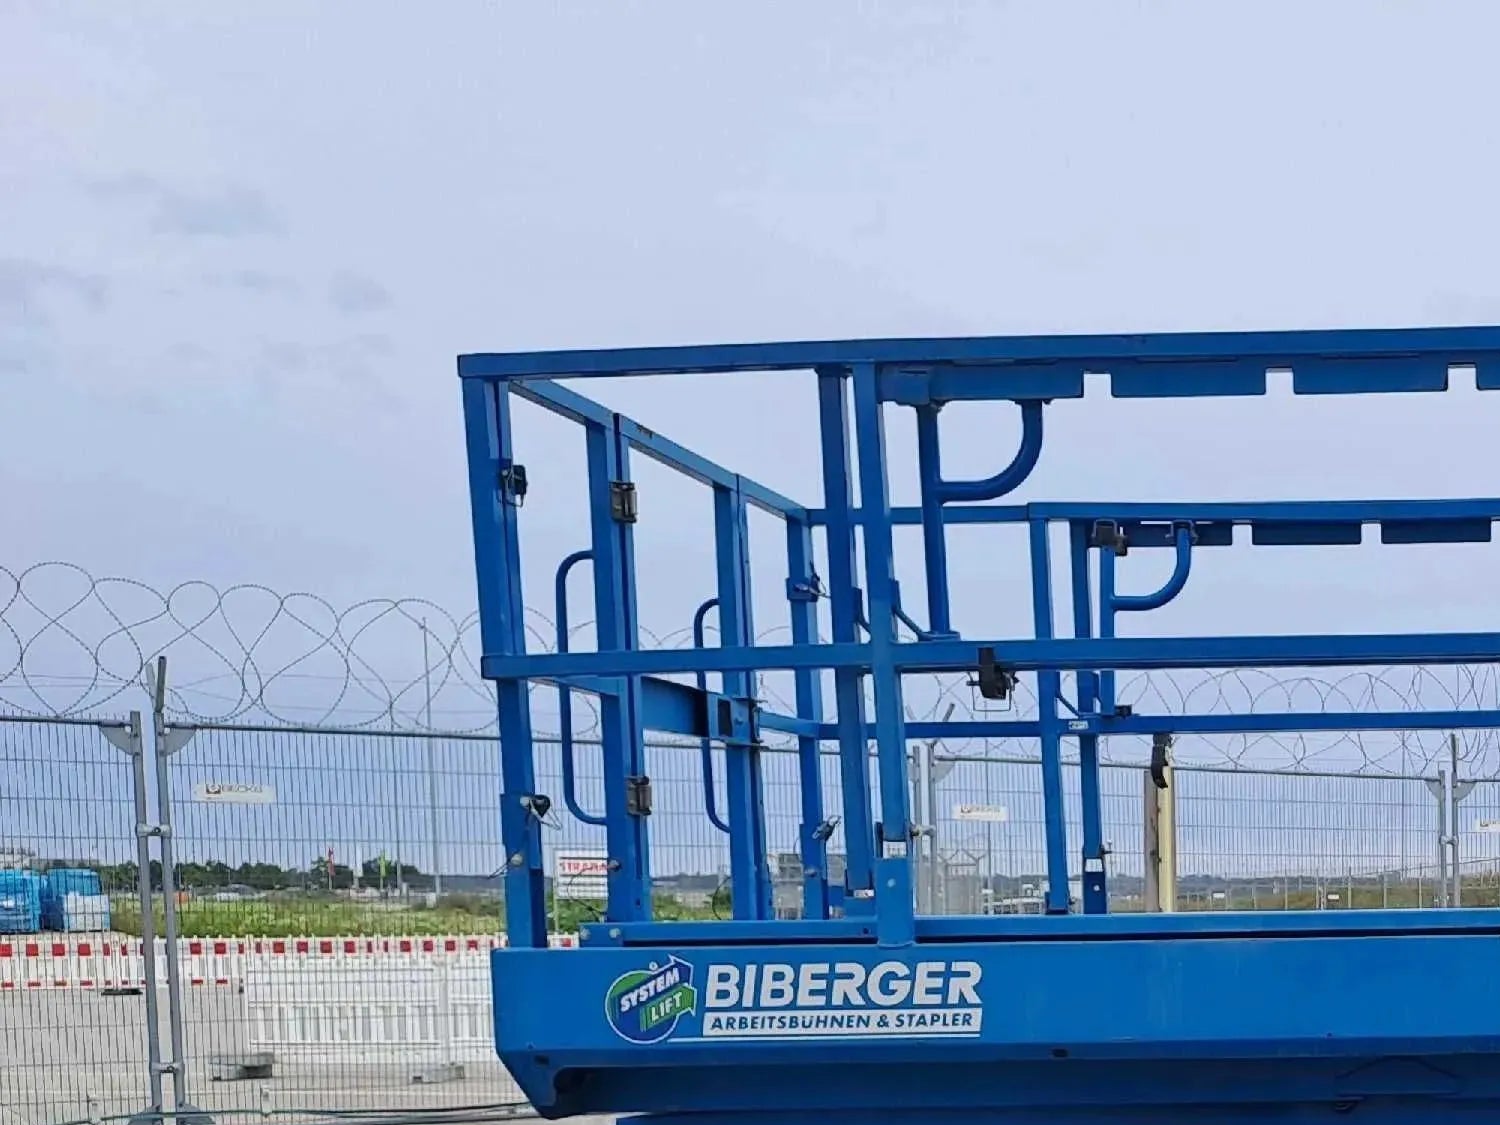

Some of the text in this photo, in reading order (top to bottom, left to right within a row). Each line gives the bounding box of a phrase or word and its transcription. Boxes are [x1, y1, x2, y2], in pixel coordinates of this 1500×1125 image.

[620, 966, 681, 1013] SYSTEM
[706, 961, 982, 1007] BIBERGER
[651, 992, 683, 1023] LIFT
[711, 1012, 974, 1031] ARBEITSBÜHNEN & STAPLER
